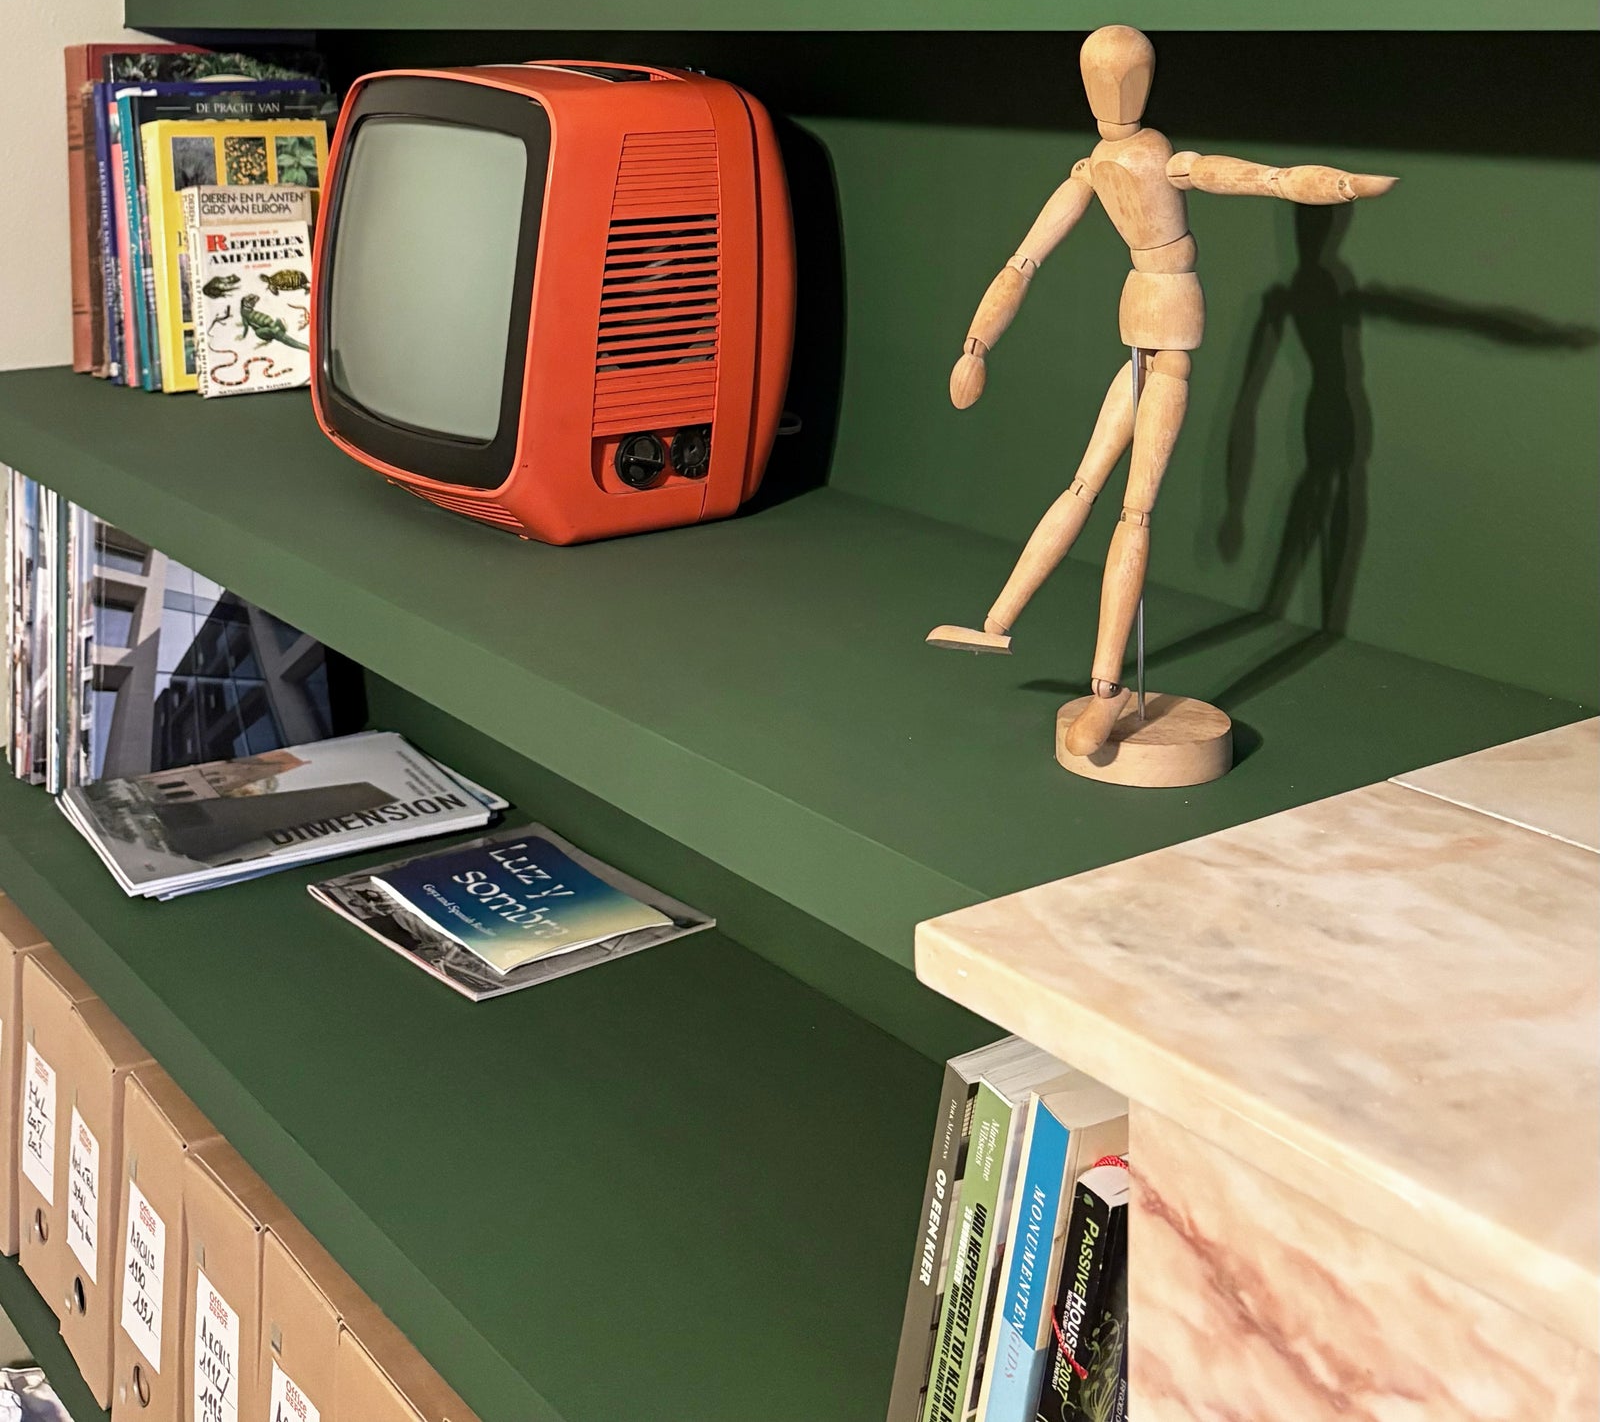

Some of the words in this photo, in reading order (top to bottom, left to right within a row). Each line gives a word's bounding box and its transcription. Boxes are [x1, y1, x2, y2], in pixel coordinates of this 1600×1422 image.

[196, 102, 210, 113] DE
[213, 102, 254, 113] PRACHT
[258, 102, 280, 113] VAN
[201, 193, 236, 204] DIEREN-
[239, 193, 254, 203] EN
[202, 204, 226, 215] GIDS
[227, 204, 250, 215] VAN
[251, 203, 292, 215] EUROPA
[206, 234, 303, 252] REPTIELEN
[266, 793, 467, 846] DIMENSION
[488, 843, 552, 885] Luz
[983, 1118, 1000, 1182] Marie-Anne
[936, 1168, 947, 1200] OP
[139, 1200, 157, 1228] Office
[927, 1197, 943, 1241] EEN
[972, 1202, 988, 1238] VAN
[919, 1240, 937, 1287] KIER
[949, 1282, 960, 1308] DOOR
[955, 1233, 982, 1338] HEPPENEERT
[1065, 1289, 1073, 1311] MORE
[209, 1291, 229, 1321] Office
[941, 1306, 958, 1361] MARKANTE
[949, 1335, 966, 1370] TOT
[936, 1356, 949, 1392] WIJKEN
[940, 1364, 960, 1416] KLEIN
[1051, 1361, 1061, 1391] ENERGY
[1057, 1358, 1073, 1402] 2007
[286, 1379, 307, 1414] Office
[932, 1389, 942, 1404] IN
